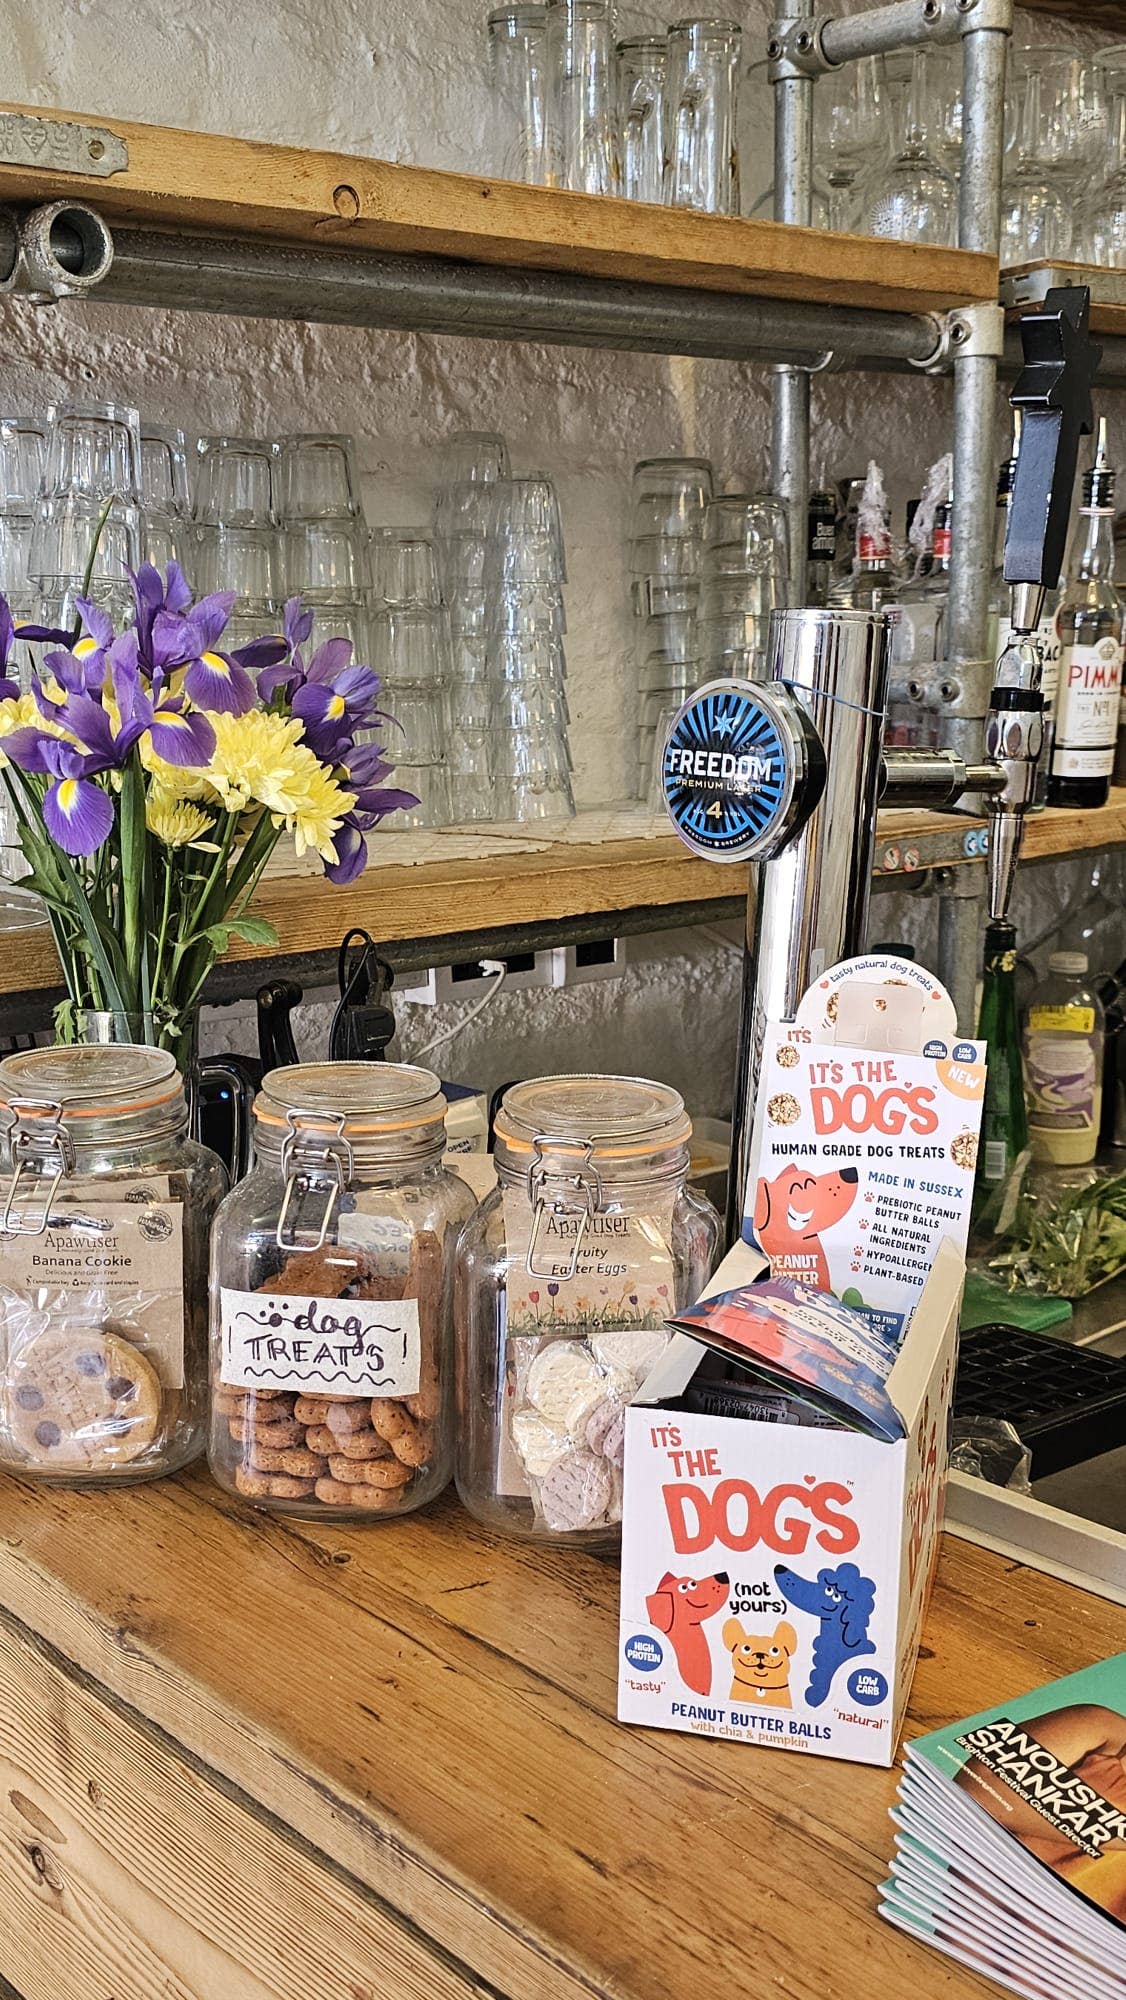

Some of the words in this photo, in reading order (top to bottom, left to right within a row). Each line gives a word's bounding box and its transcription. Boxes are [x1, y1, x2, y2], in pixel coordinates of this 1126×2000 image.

[669, 749, 772, 781] FREEDOM
[675, 778, 723, 790] PREMIUM
[706, 801, 723, 819] 4
[830, 966, 853, 983] tasty
[855, 960, 888, 971] natural
[890, 961, 908, 975] dog
[909, 968, 933, 991] treats
[852, 1060, 897, 1083] THE
[947, 1065, 982, 1090] NEW
[448, 1139, 469, 1152] OPEN
[772, 1143, 817, 1156] HUMAN
[823, 1144, 862, 1157] GRADE
[867, 1145, 894, 1157] DOG
[899, 1147, 945, 1159] TREATS
[868, 1171, 899, 1186] MADE
[904, 1177, 915, 1189] IN
[919, 1181, 964, 1199] SUSSEX
[875, 1207, 909, 1222] BUTTER
[912, 1215, 940, 1229] BALLS
[877, 1195, 922, 1213] PREBIOTIC
[925, 1206, 962, 1221] PEANUT
[872, 1222, 889, 1234] ALL
[891, 1228, 931, 1243] NATURAL
[870, 1235, 926, 1255] INGREDIENTS
[32, 1255, 81, 1266] Banana
[85, 1255, 132, 1266] Cookie
[597, 1263, 627, 1276] Eggs
[863, 1265, 924, 1286] PLANT-BASED
[294, 1300, 363, 1356] dog
[872, 1314, 880, 1322] TO
[882, 1316, 897, 1325] FIND
[243, 1333, 384, 1371] TREATS
[667, 1449, 721, 1477] THE
[734, 1581, 771, 1598] (not
[729, 1598, 787, 1615] yours)
[627, 1650, 661, 1664] PROTEIN
[634, 1642, 655, 1653] HIGH
[856, 1684, 880, 1697] CARB
[858, 1675, 878, 1687] LOW
[672, 1702, 726, 1723] PEANUT
[731, 1712, 784, 1734] BUTTER
[789, 1720, 832, 1740] BALLS
[691, 1721, 714, 1735] with
[719, 1725, 742, 1739] chia
[746, 1730, 754, 1740] &
[758, 1733, 809, 1750] pumpkin
[968, 1729, 1111, 1847] SHANKAR
[987, 1722, 1126, 1842] ANOUSHK
[956, 1737, 996, 1771] Brighton
[994, 1768, 1032, 1801] Festival
[1030, 1799, 1061, 1826] Guest
[1060, 1824, 1101, 1858] Director
